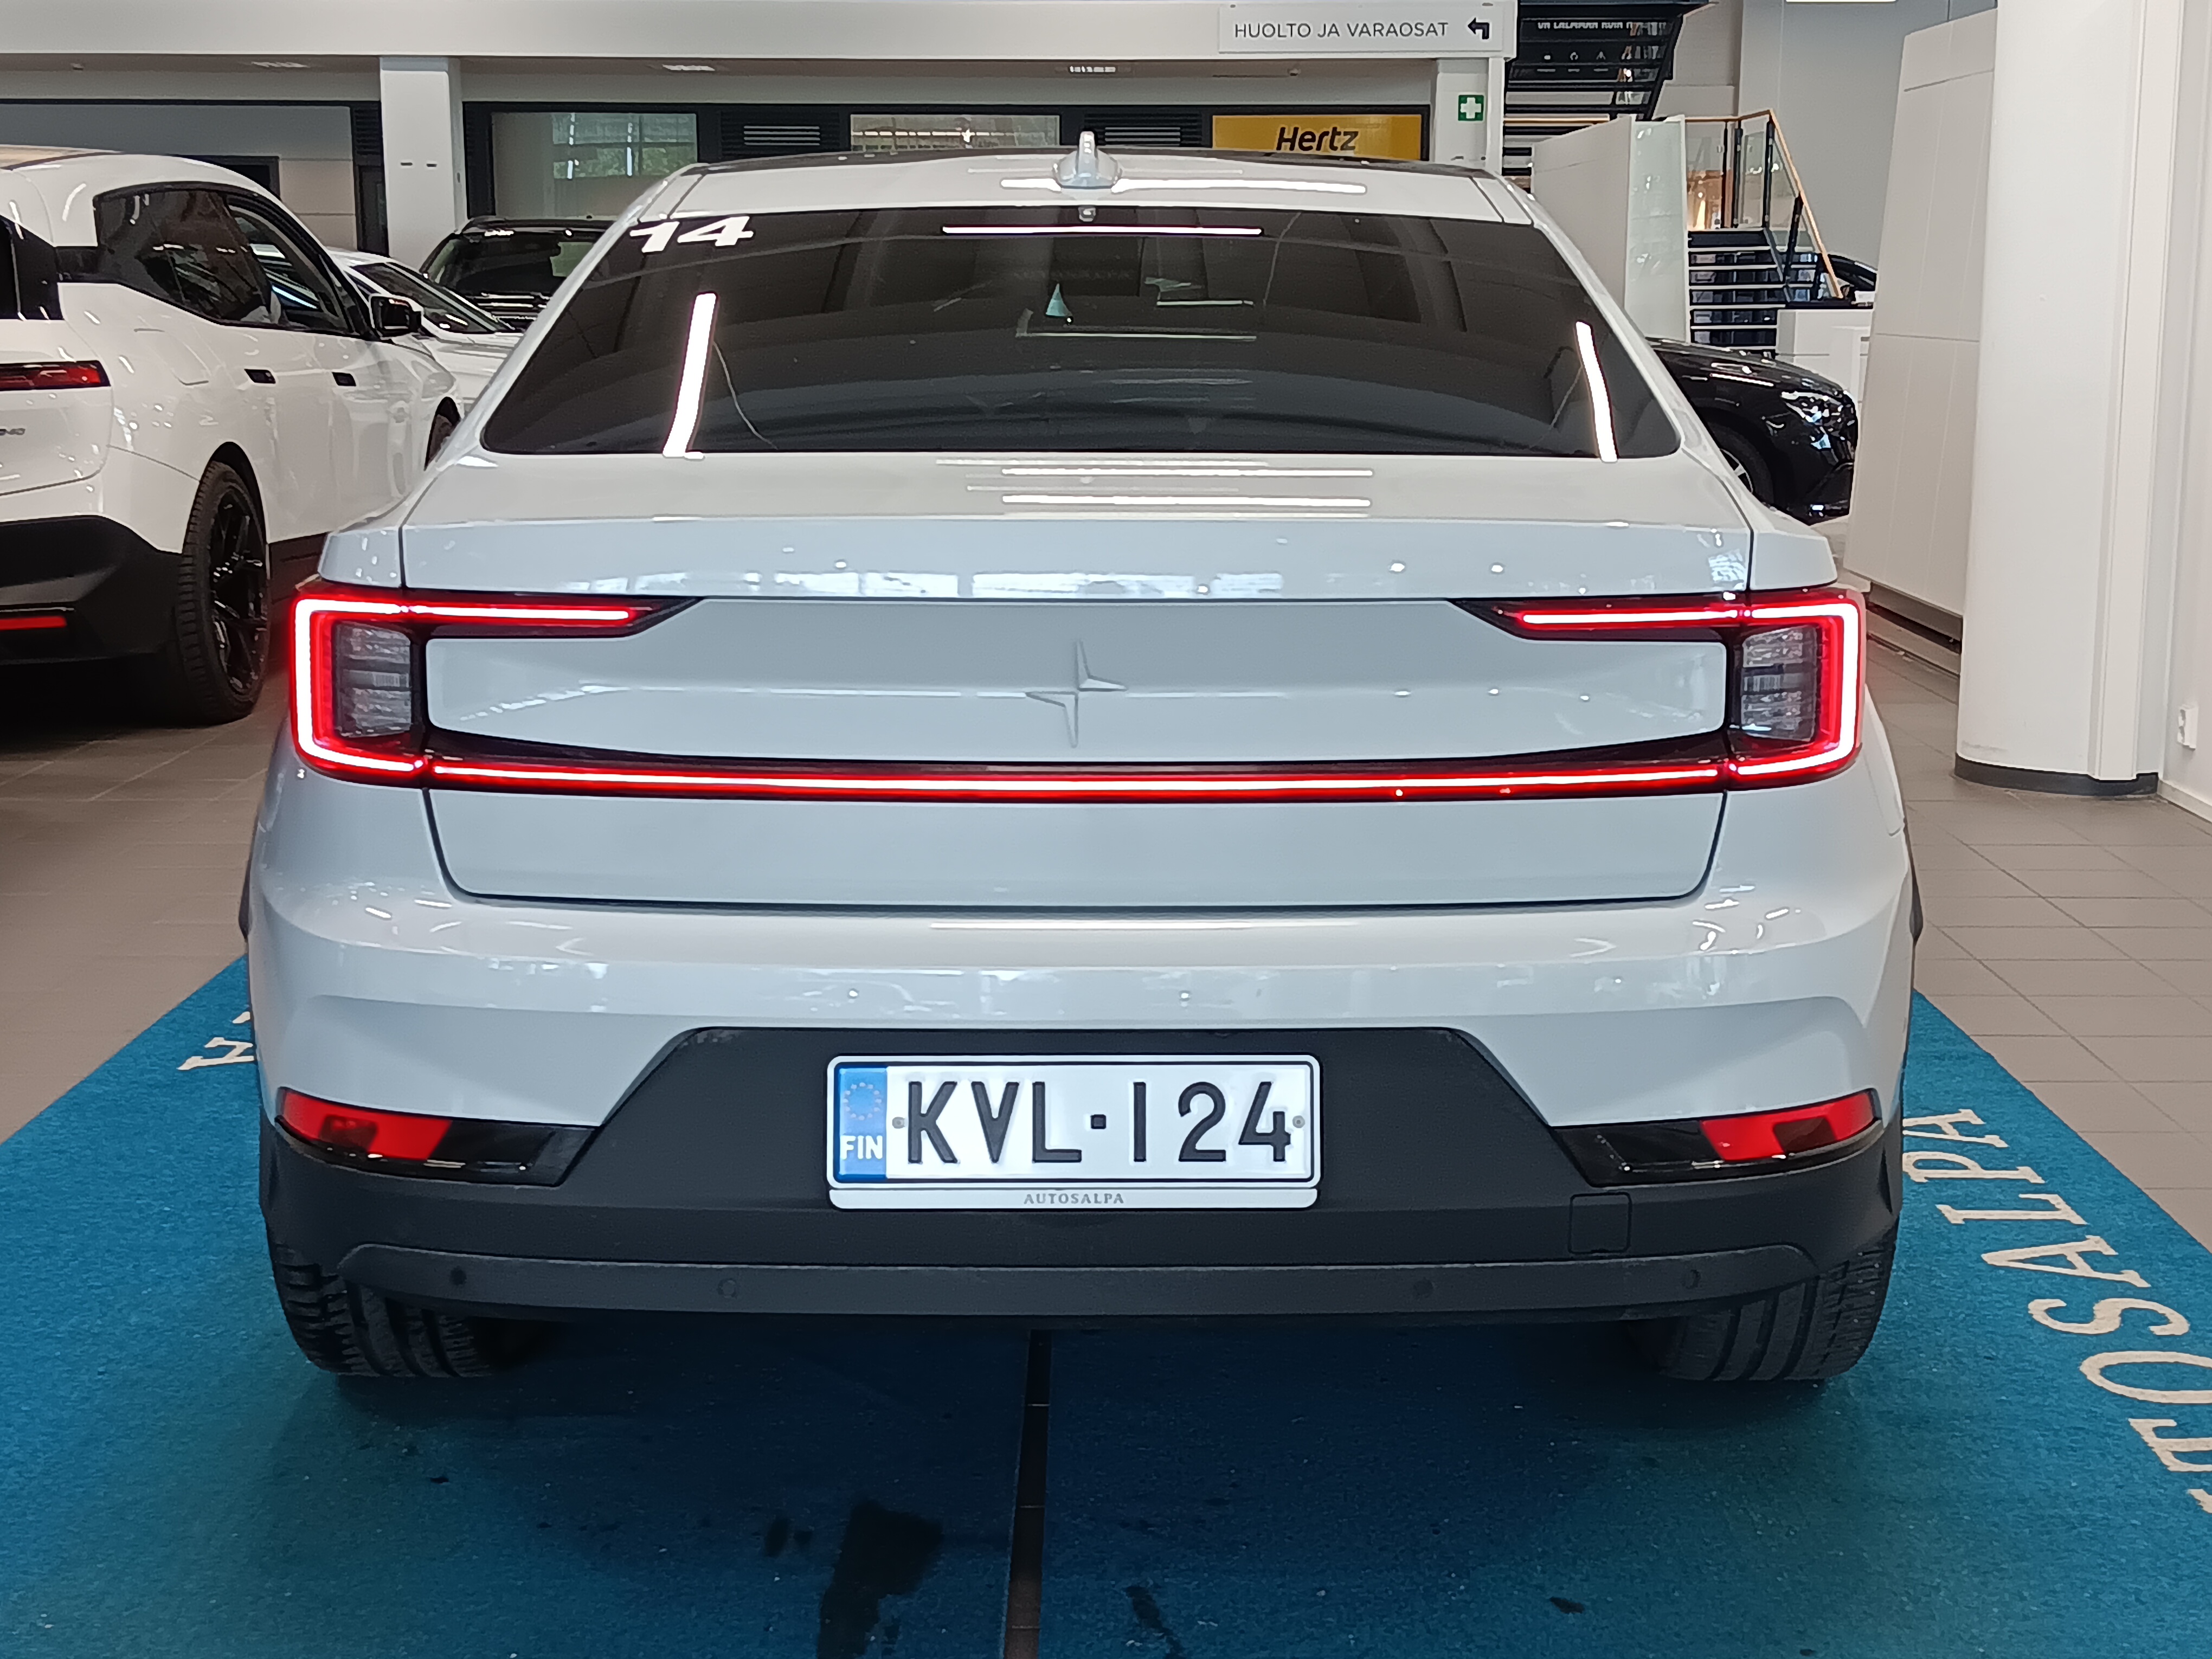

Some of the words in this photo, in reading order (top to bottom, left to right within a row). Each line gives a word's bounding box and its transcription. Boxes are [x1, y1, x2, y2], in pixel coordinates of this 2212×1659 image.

[1235, 23, 1311, 37] HUOLTO
[1317, 23, 1340, 37] JA
[1347, 22, 1449, 36] VARAOSAT
[1276, 126, 1359, 151] Hertz
[629, 216, 754, 253] 14
[840, 1135, 883, 1159] FIN
[1024, 1193, 1124, 1204] AUTOSALPA
